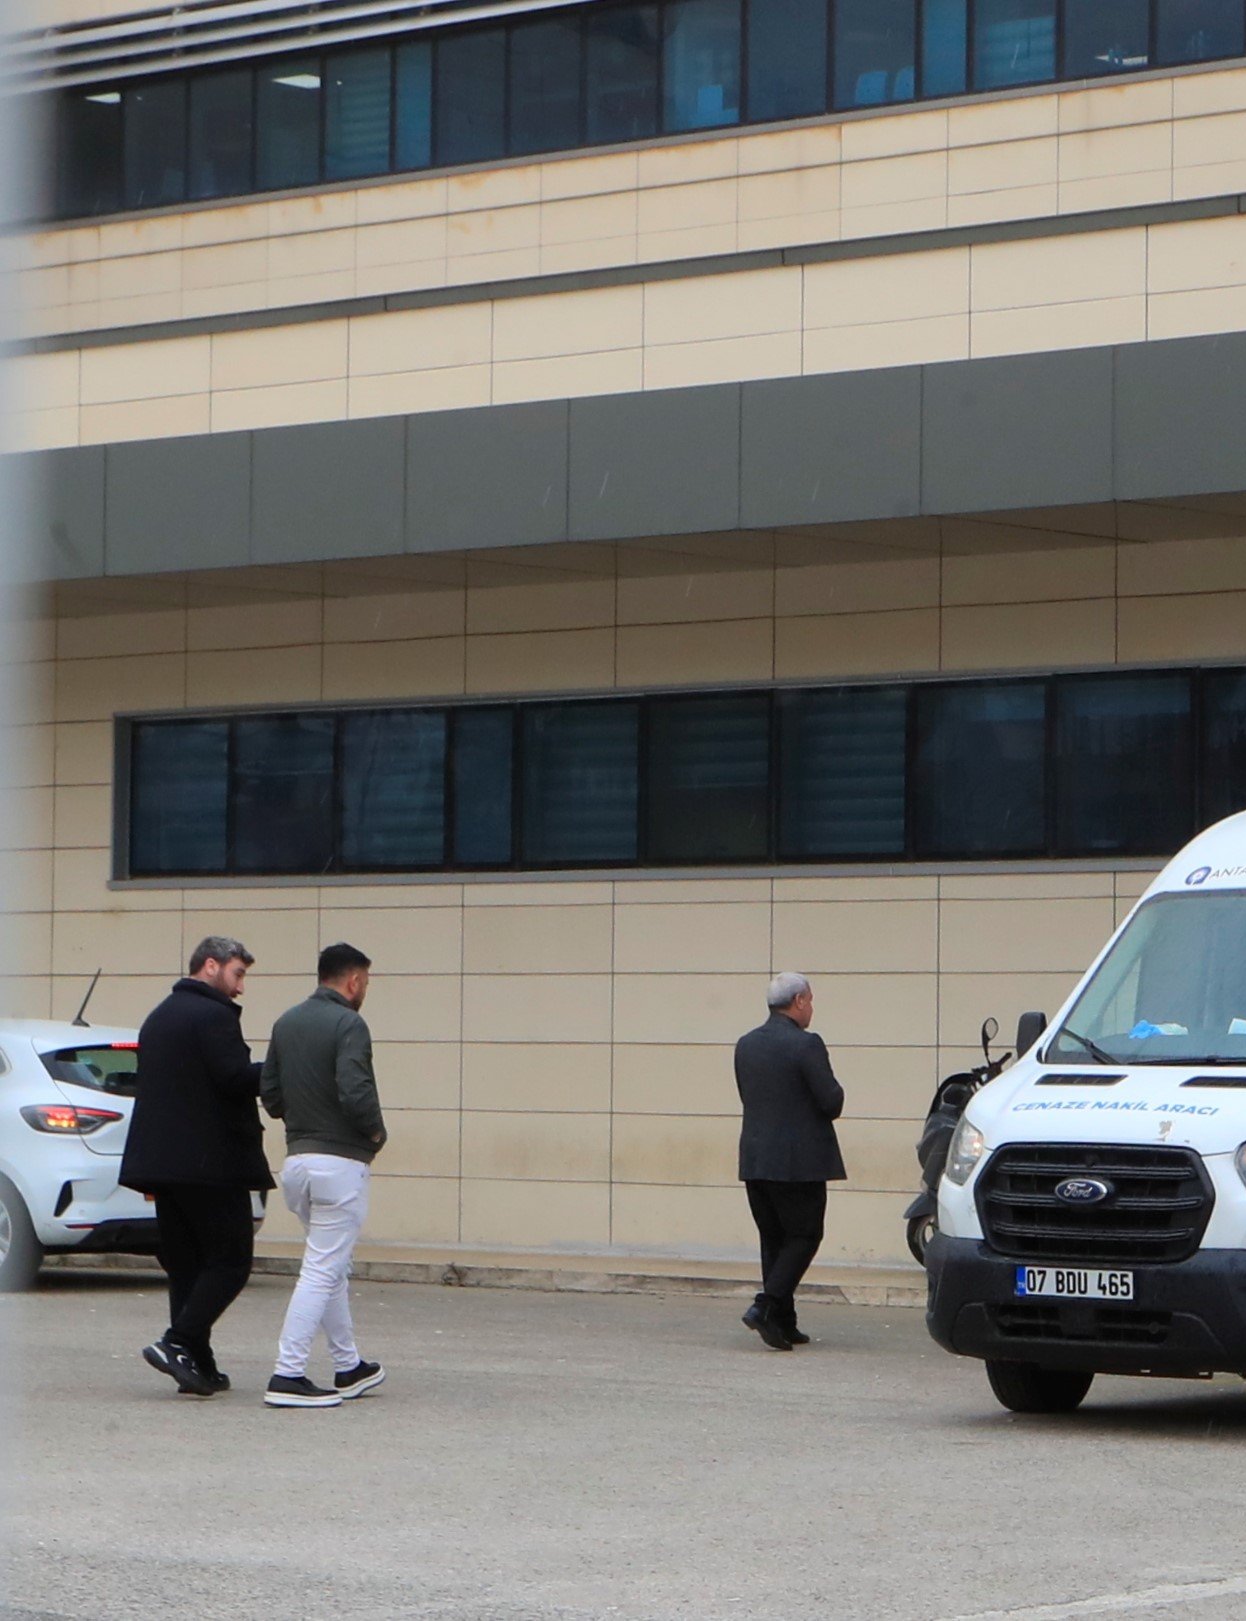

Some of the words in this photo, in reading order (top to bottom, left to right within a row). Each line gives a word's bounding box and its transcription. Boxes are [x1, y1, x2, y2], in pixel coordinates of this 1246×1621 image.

[1013, 1101, 1087, 1112] CENAZE
[1091, 1101, 1150, 1112] NAKİL
[1153, 1103, 1218, 1116] ARACI
[1064, 1182, 1093, 1197] Ford
[1027, 1269, 1047, 1293] 07
[1056, 1271, 1088, 1295] BDU
[1098, 1272, 1131, 1297] 465
